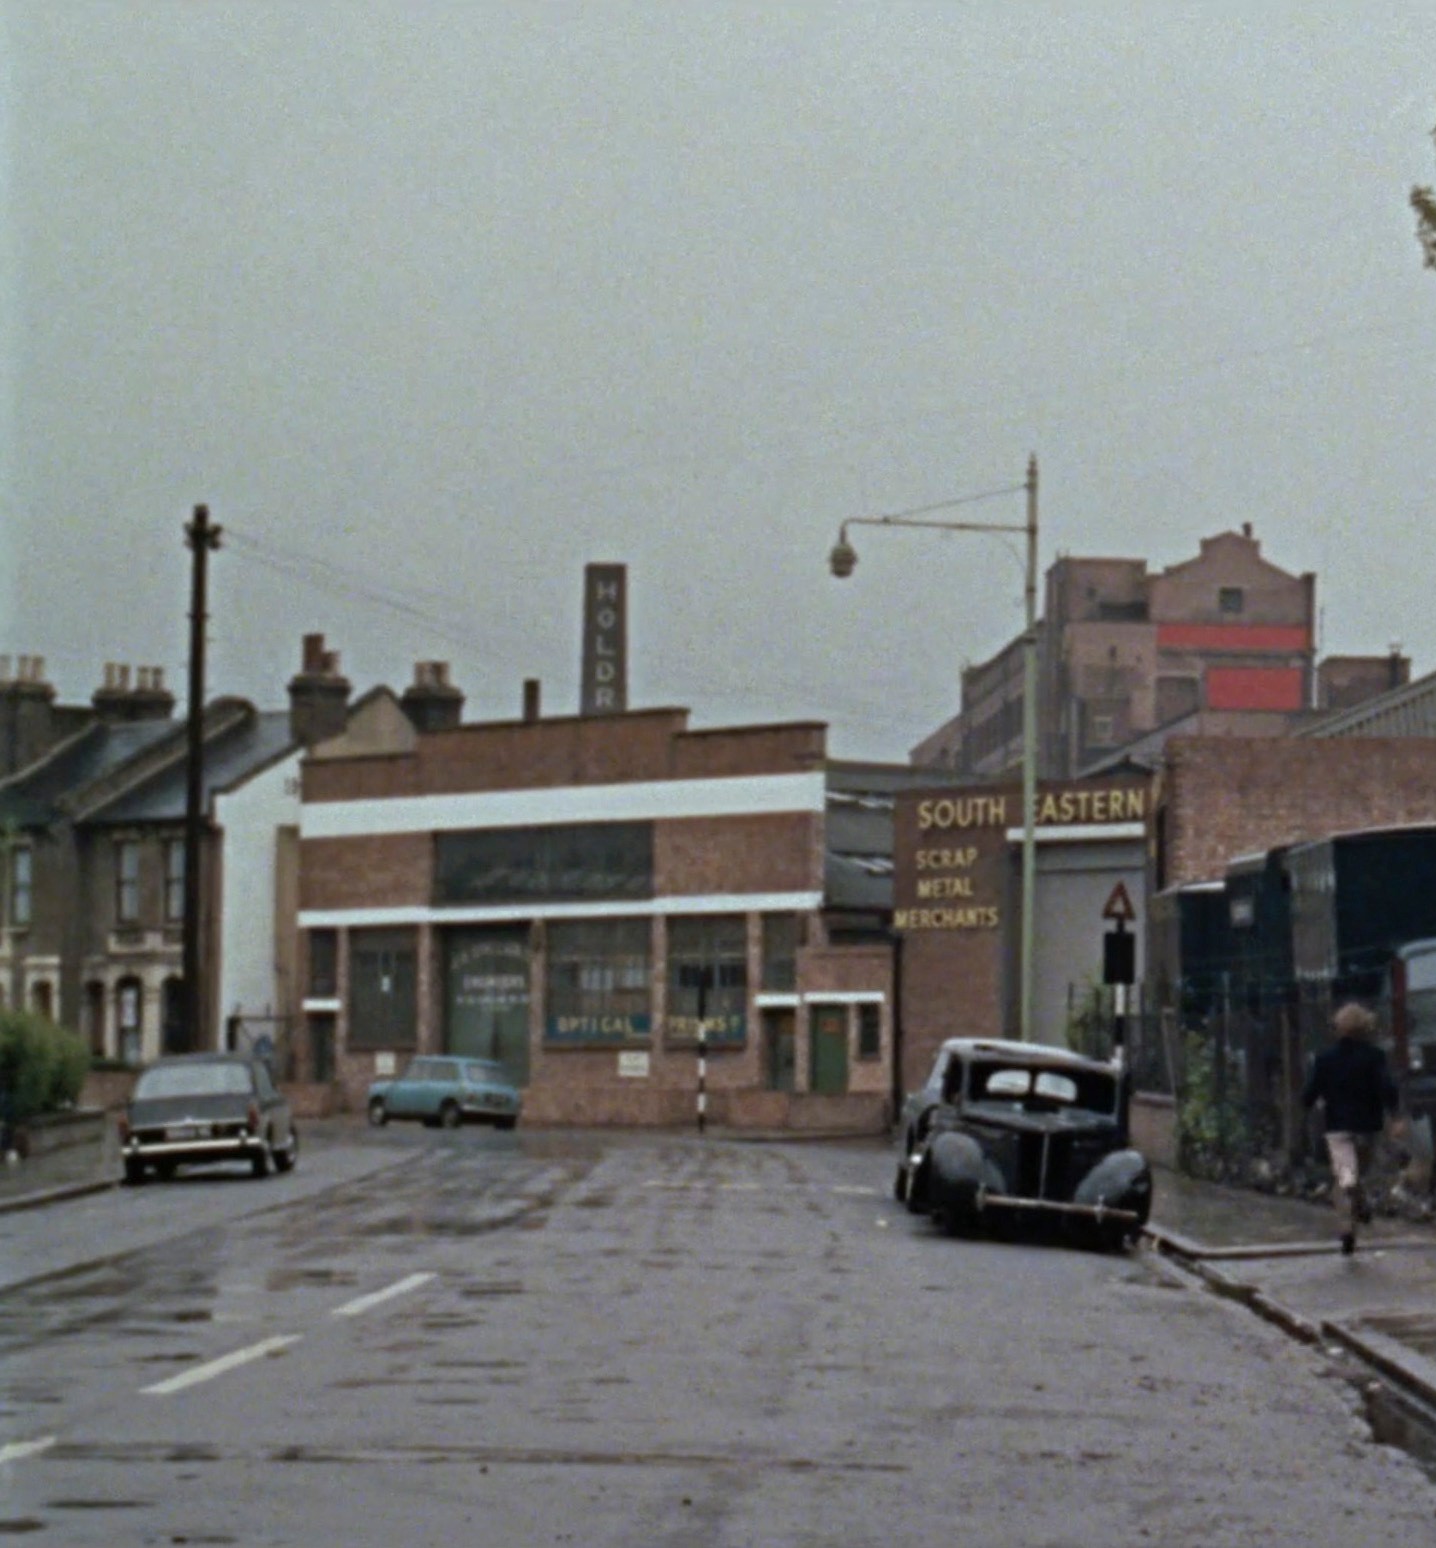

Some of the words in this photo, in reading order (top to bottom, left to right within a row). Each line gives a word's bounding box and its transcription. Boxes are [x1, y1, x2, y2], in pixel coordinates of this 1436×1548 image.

[918, 798, 1005, 828] SOUTH
[915, 848, 977, 869] SCRAP
[917, 877, 973, 897] METAL
[894, 906, 999, 929] MERCHANTS
